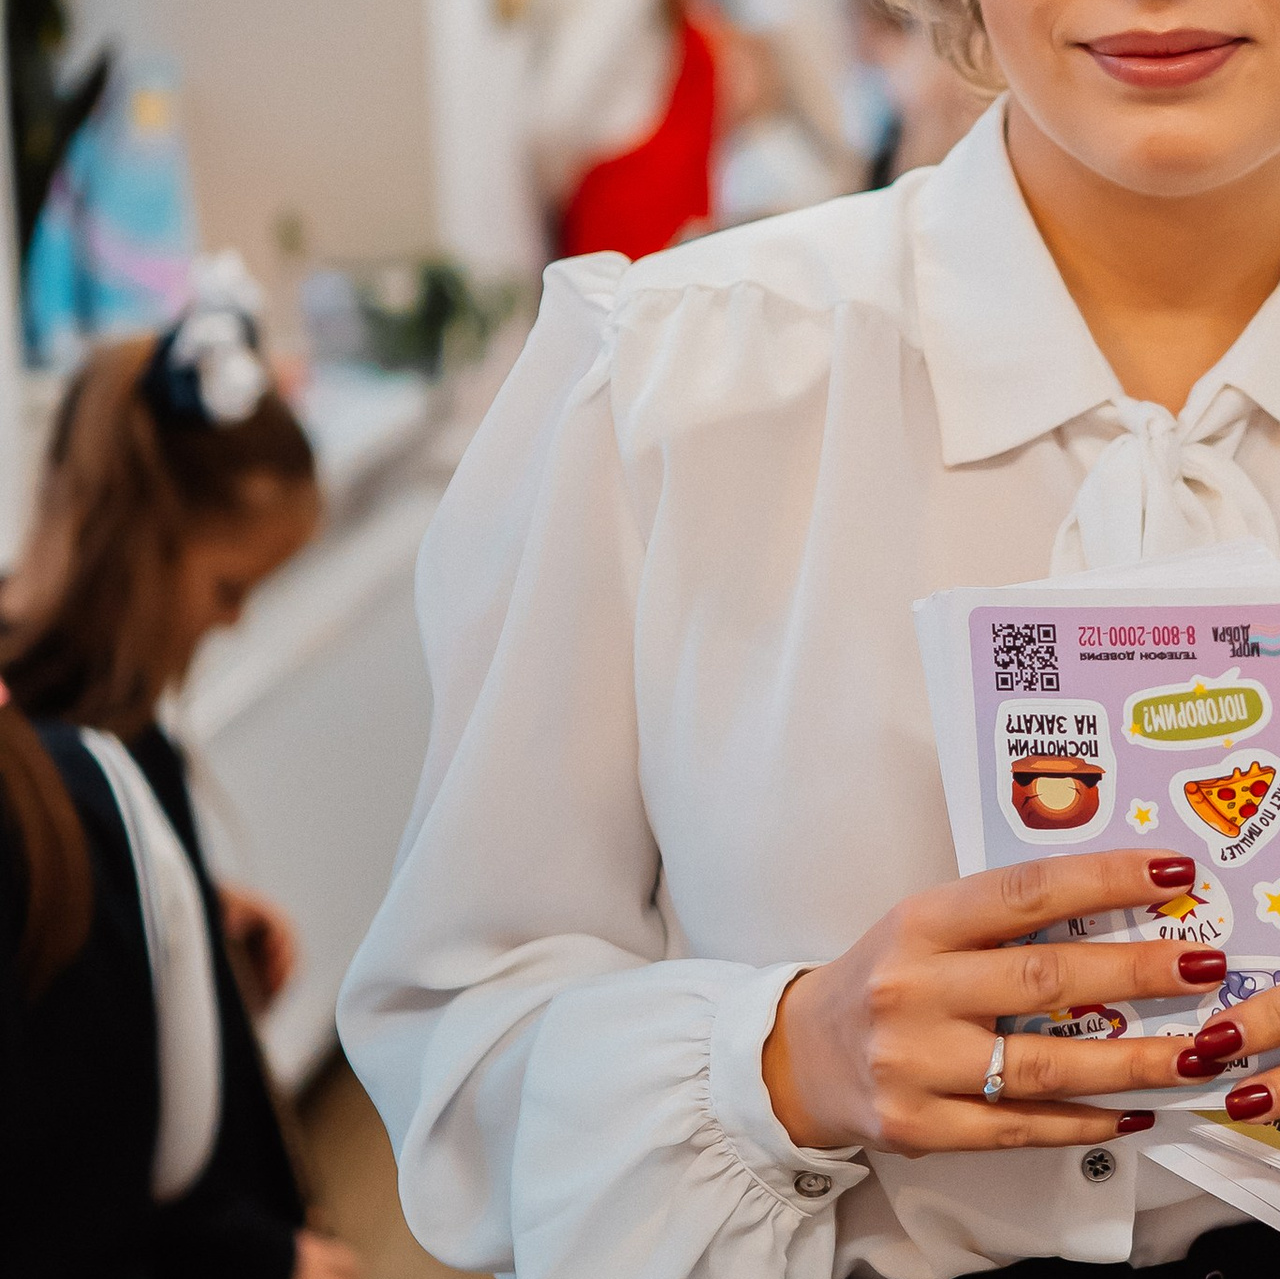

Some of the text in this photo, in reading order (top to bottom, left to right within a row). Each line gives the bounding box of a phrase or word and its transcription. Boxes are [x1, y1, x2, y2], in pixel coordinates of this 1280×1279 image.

[1078, 625, 1196, 646] 8-800-2000-122
[1212, 624, 1250, 642] ДОБРА
[1079, 651, 1197, 660] ТЕЛЕФОН ДОВЕРИЯ
[1230, 642, 1260, 658] МОРЕ
[1143, 693, 1248, 733] ПОГОВОРИМ?
[1006, 714, 1097, 735] НА ЗАКАТ?
[1007, 739, 1099, 757] ПОСМОТРИМ
[1259, 808, 1276, 826] ПО
[1220, 822, 1263, 861] ПИЦЦЕ?
[1159, 920, 1221, 943] ТУСИТЬ
[1086, 1017, 1105, 1033] ЭТУ
